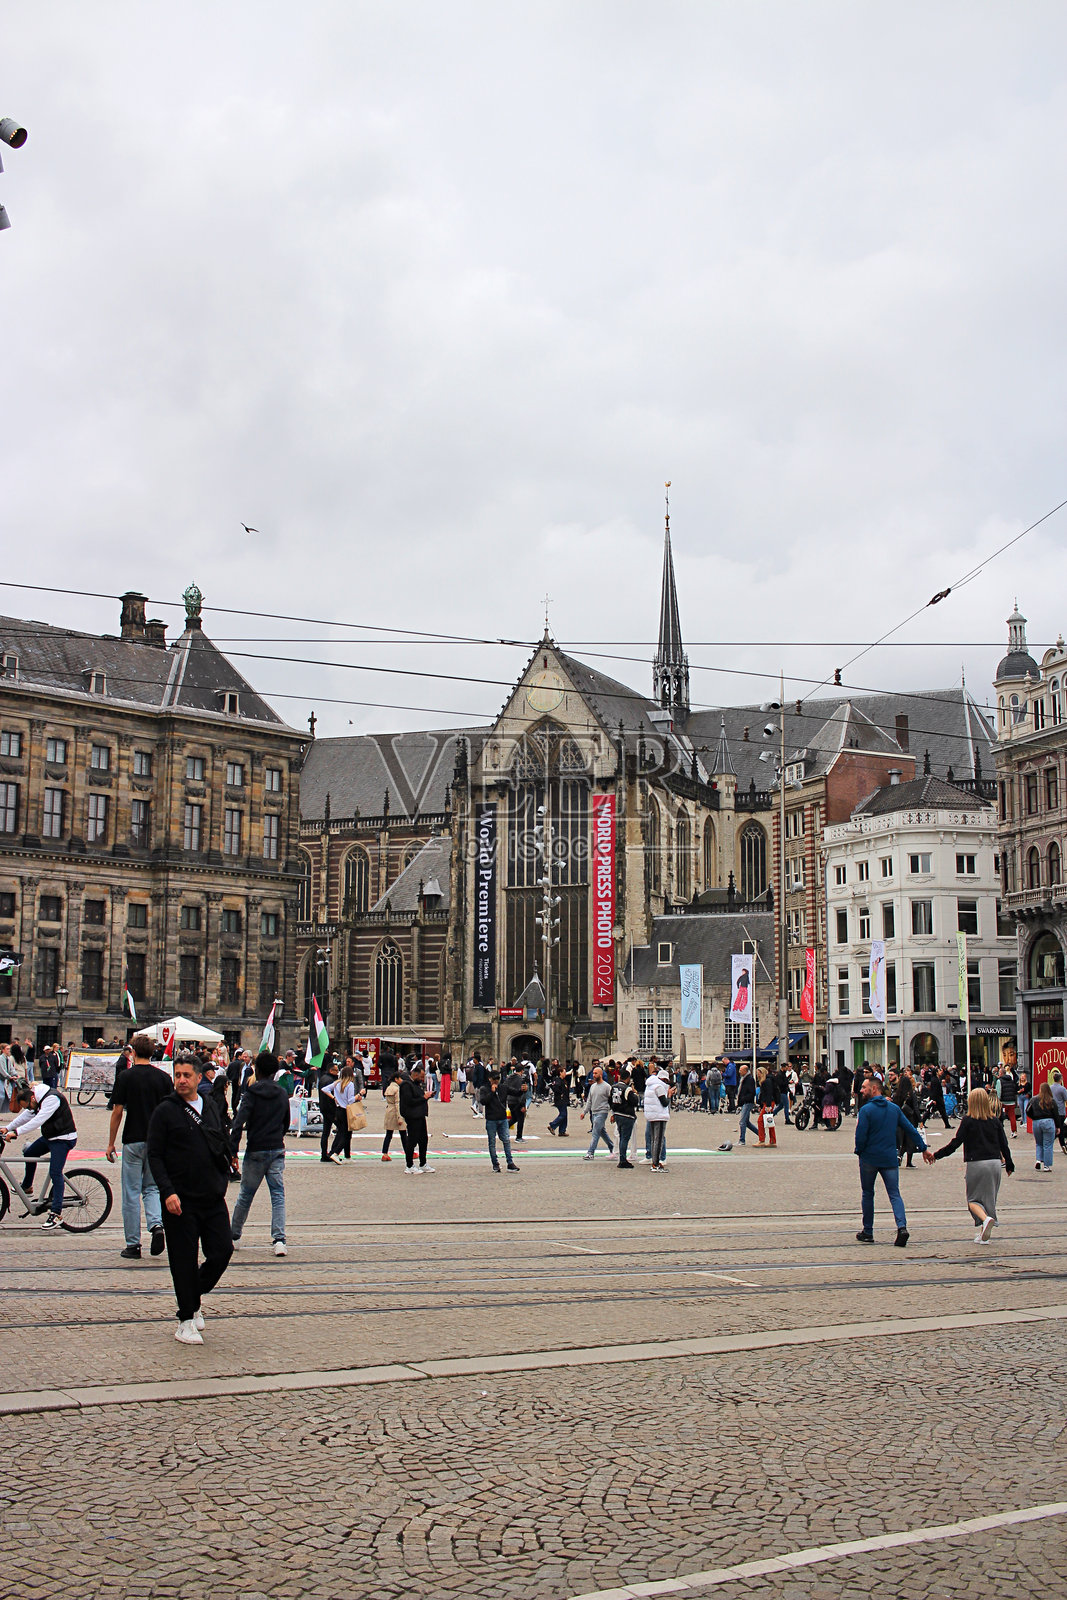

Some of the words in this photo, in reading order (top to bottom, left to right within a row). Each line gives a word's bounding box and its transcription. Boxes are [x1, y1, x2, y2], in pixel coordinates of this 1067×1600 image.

[479, 811, 493, 864] World
[597, 803, 612, 854] WORLD
[597, 856, 612, 898] PRESS
[478, 869, 492, 952] Premiere
[597, 901, 612, 948] PHOTO
[597, 954, 612, 998] 2024
[977, 1027, 1010, 1035] SWAROVSKI
[1035, 1048, 1067, 1075] HOTDO
